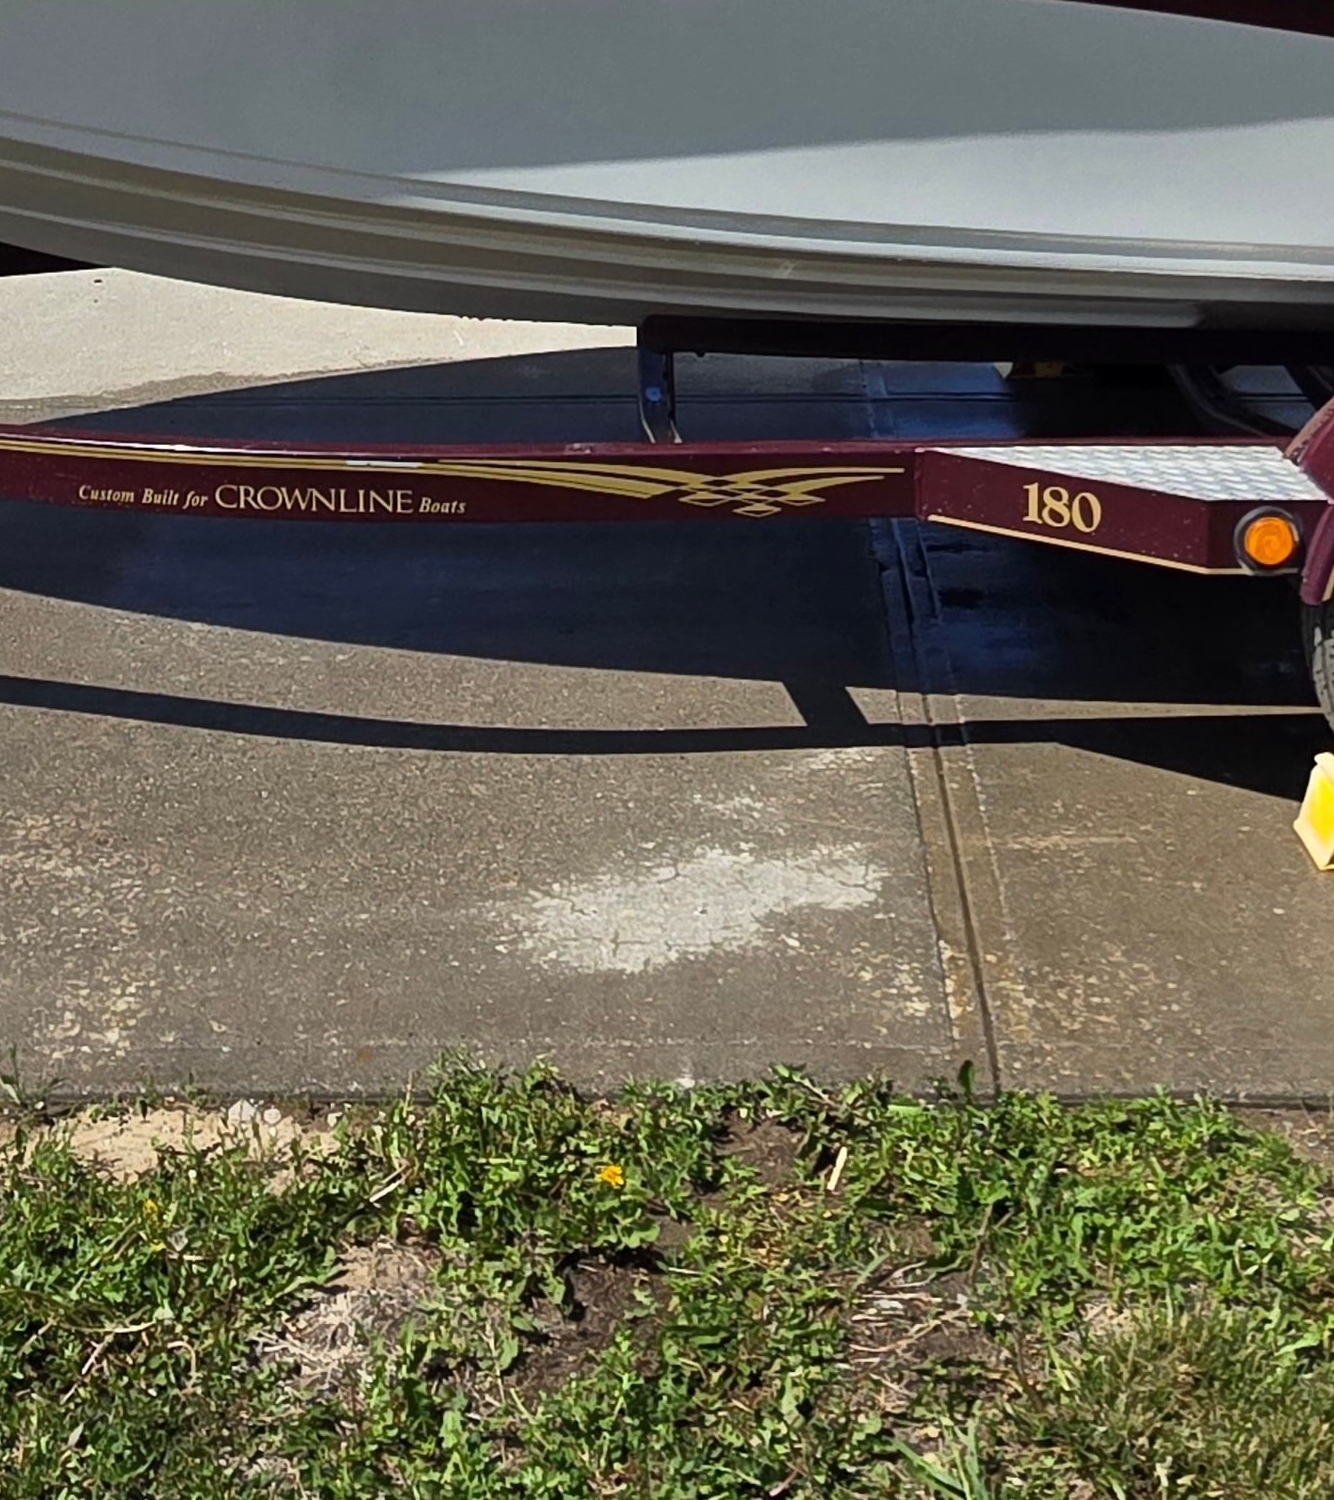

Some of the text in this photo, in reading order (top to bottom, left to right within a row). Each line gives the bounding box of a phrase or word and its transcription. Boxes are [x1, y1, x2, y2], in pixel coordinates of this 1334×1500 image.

[78, 483, 467, 516] Custom Built for CROWNLINE Boats
[1021, 482, 1102, 534] 180
